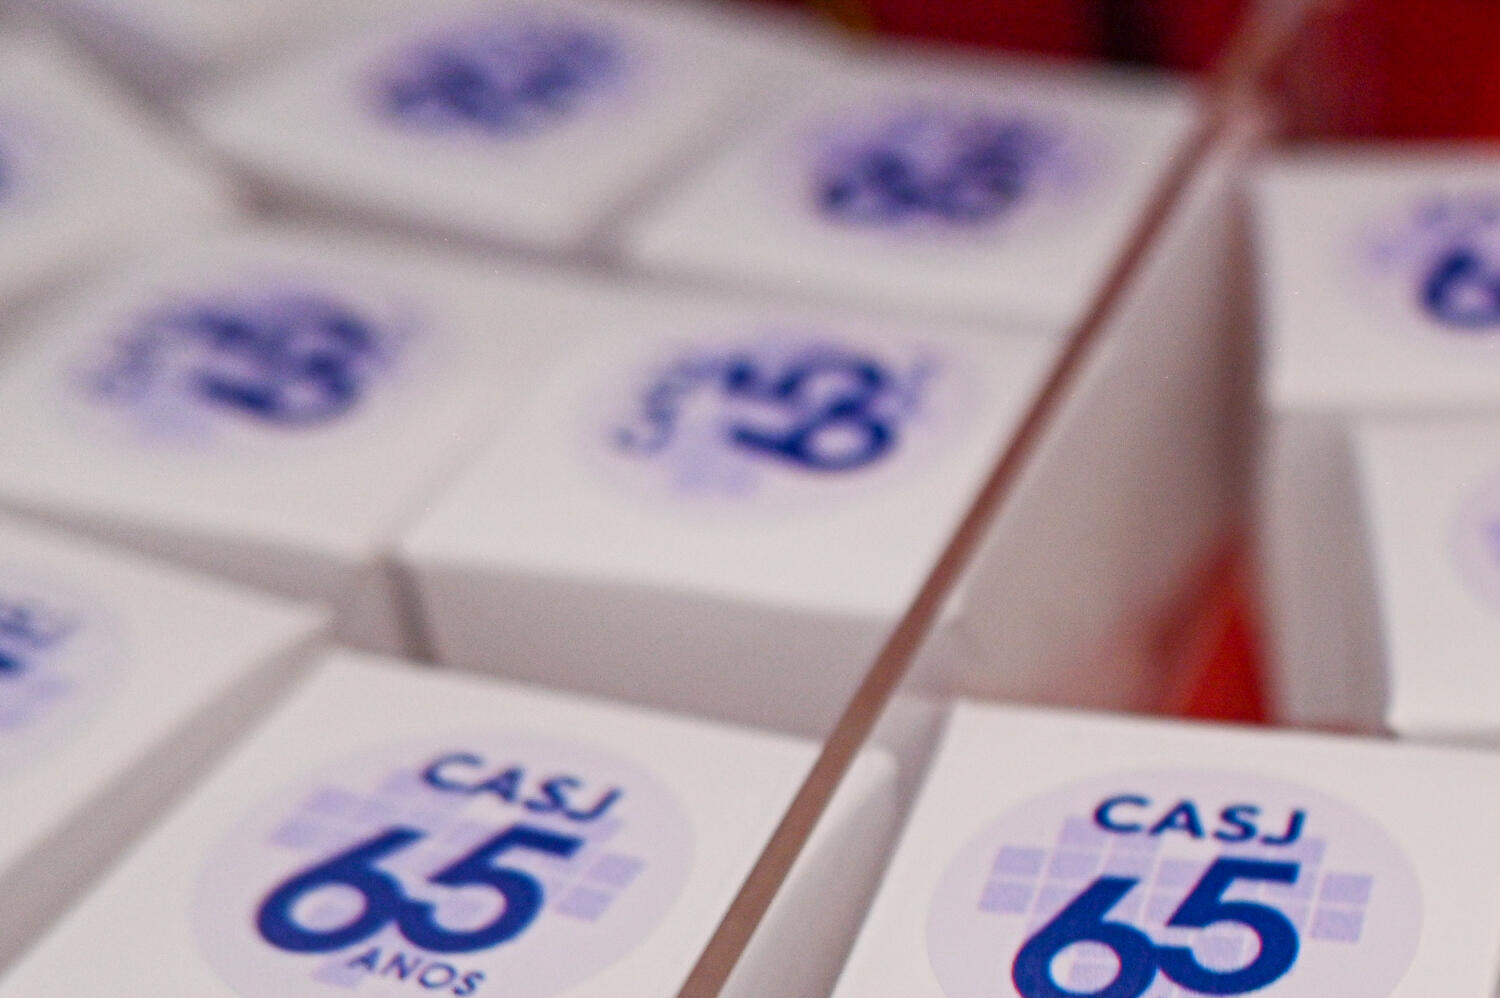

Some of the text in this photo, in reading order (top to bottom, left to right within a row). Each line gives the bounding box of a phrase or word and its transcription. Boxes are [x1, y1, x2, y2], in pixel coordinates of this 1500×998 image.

[420, 752, 624, 822] CASJ
[1093, 794, 1307, 846] CASJ
[254, 824, 586, 955] 65
[346, 946, 486, 998] ANOS
